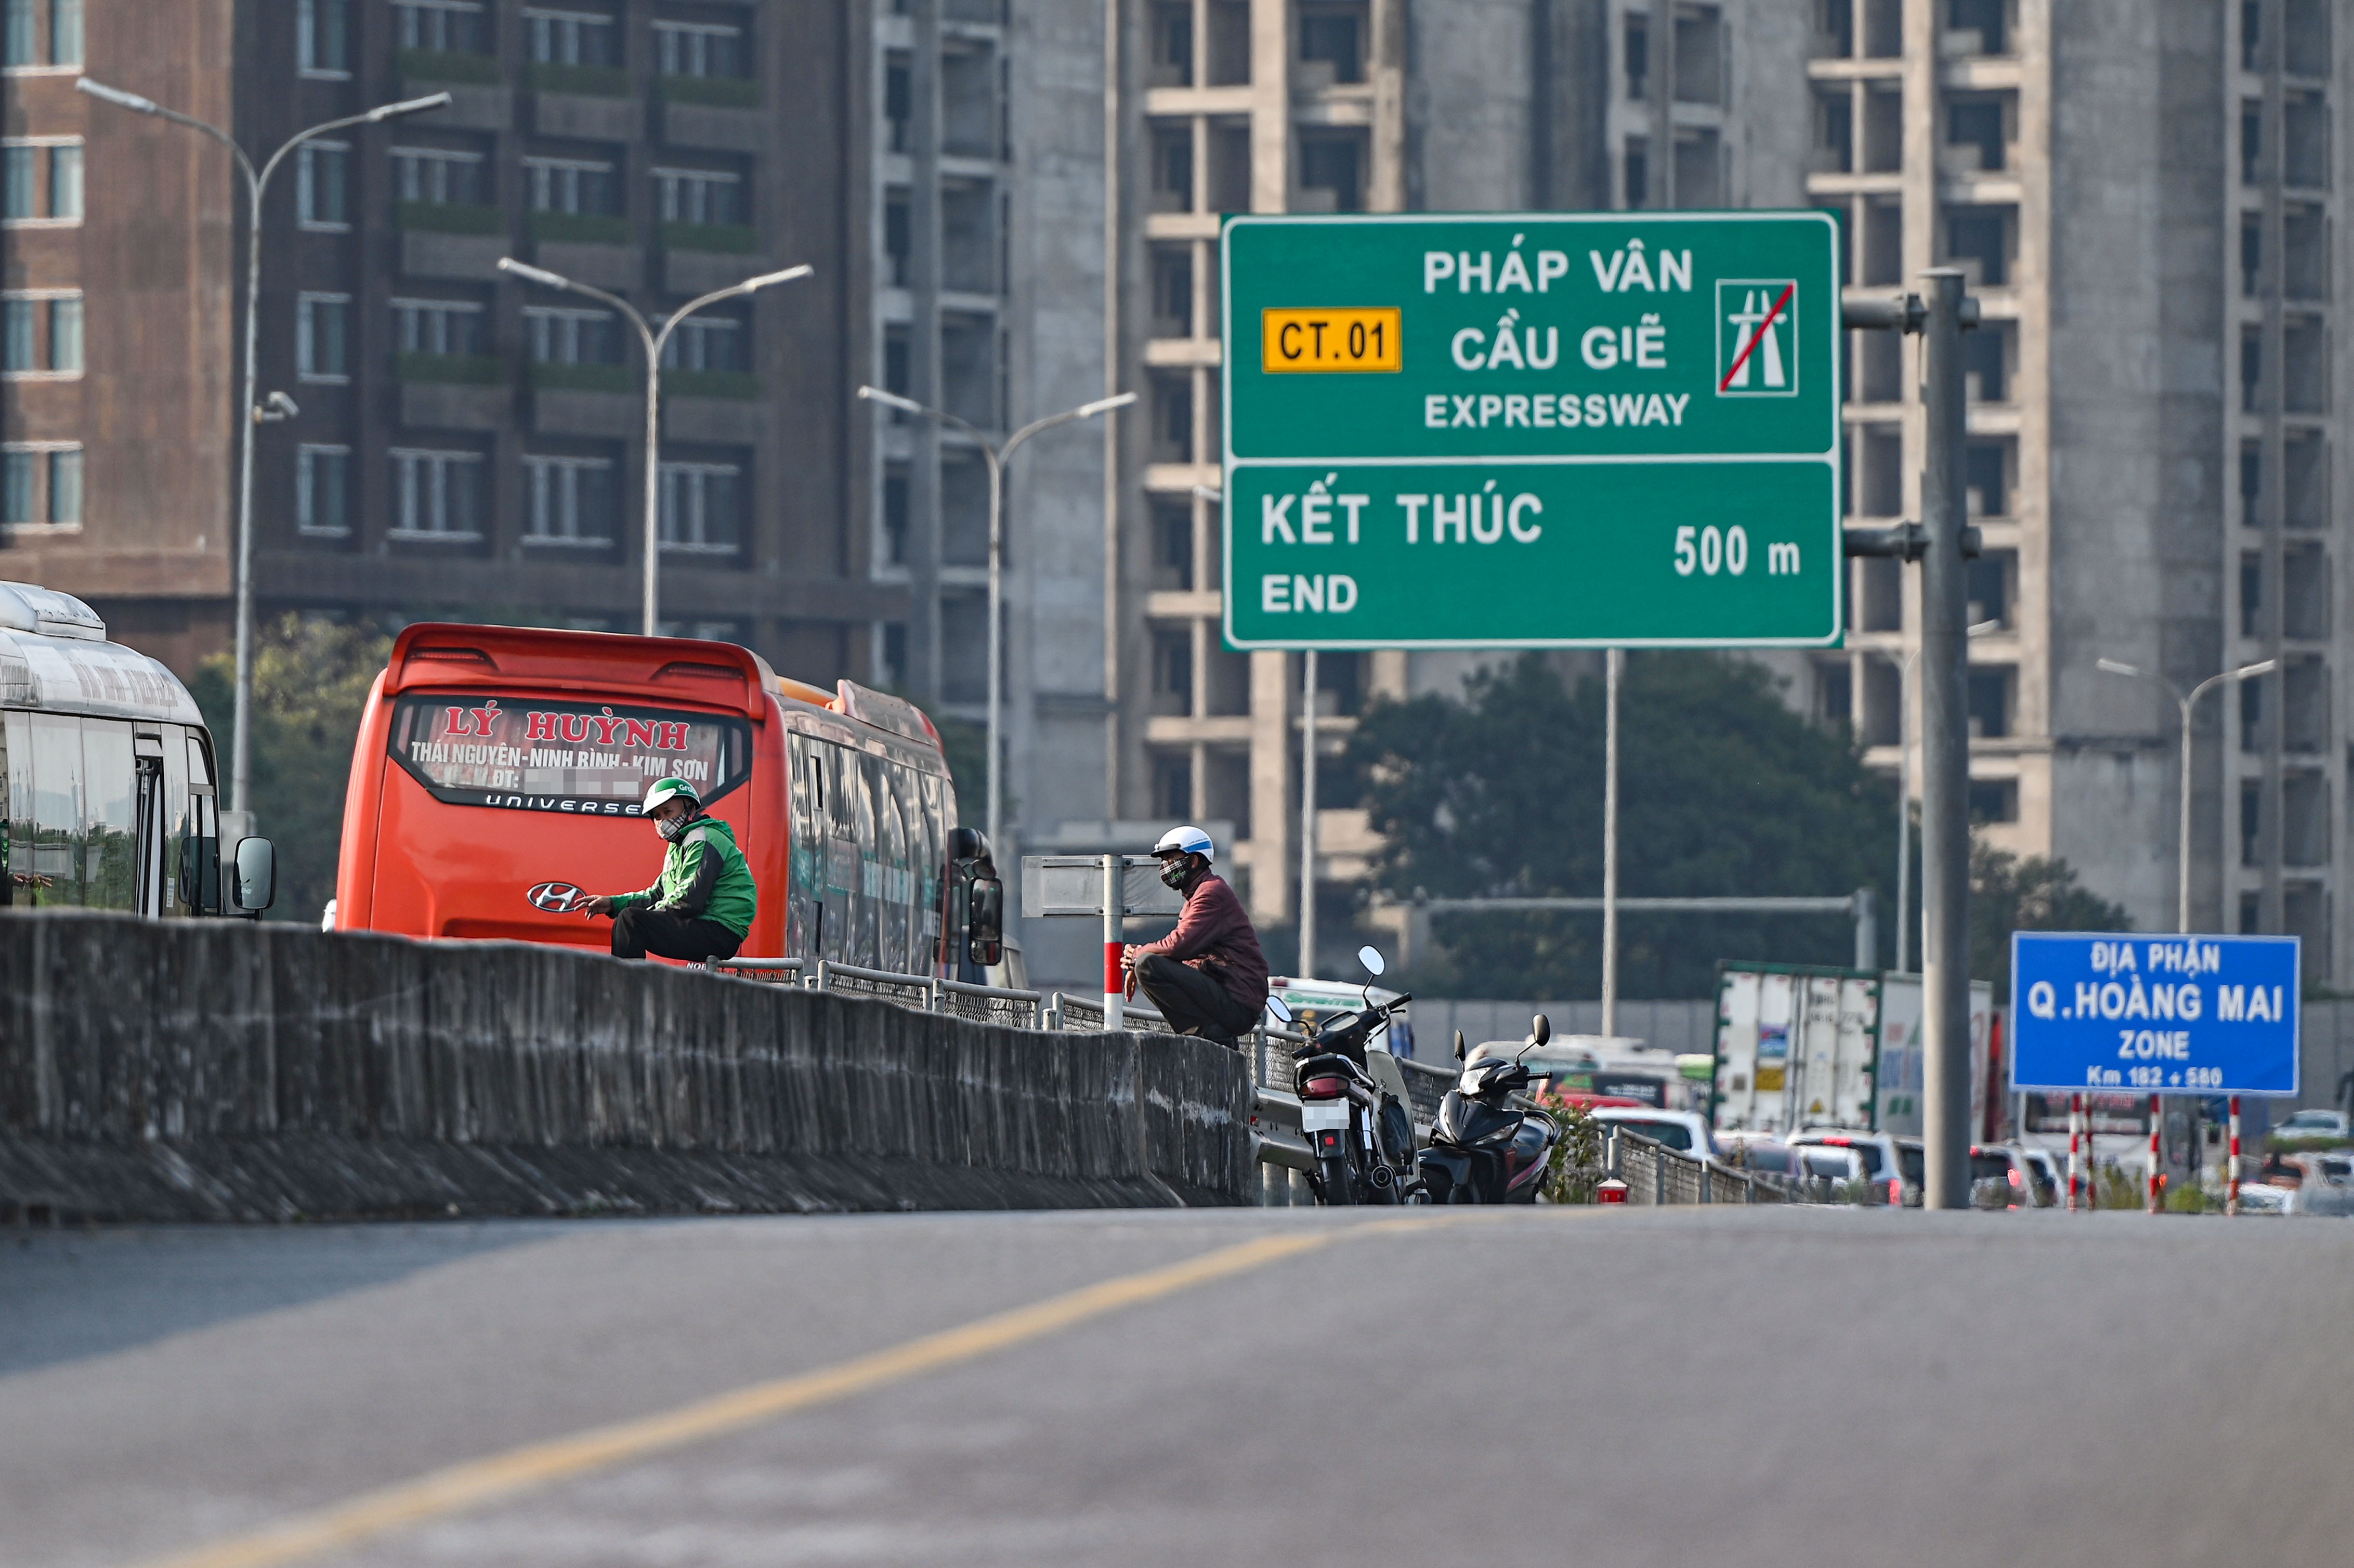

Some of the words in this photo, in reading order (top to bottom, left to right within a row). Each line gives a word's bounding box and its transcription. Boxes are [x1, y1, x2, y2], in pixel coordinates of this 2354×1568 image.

[1424, 234, 1569, 293] PHÁP
[1589, 238, 1693, 292] VÂN
[1279, 321, 1387, 360] CT.01
[1451, 308, 1559, 371] CẦU
[1581, 314, 1667, 369] GIẼ
[1425, 394, 1691, 427] EXPRESSWAY
[1262, 473, 1369, 544] KẾT
[1396, 480, 1543, 543] THÚC
[1674, 525, 1748, 576] 500
[1769, 541, 1800, 575] m
[1262, 574, 1358, 613] END
[445, 700, 503, 737] LÝ
[525, 706, 690, 751] HUỲNH
[412, 739, 449, 763] THÁI
[671, 759, 709, 781] SƠN
[493, 769, 520, 789] ĐT:
[486, 794, 644, 815] UNIVERSE
[2090, 940, 2137, 979] ĐỊA
[2148, 937, 2221, 980] PHẬN
[2217, 984, 2284, 1023] MAI
[2118, 1029, 2190, 1061] ZONE
[2087, 1065, 2122, 1086] Km
